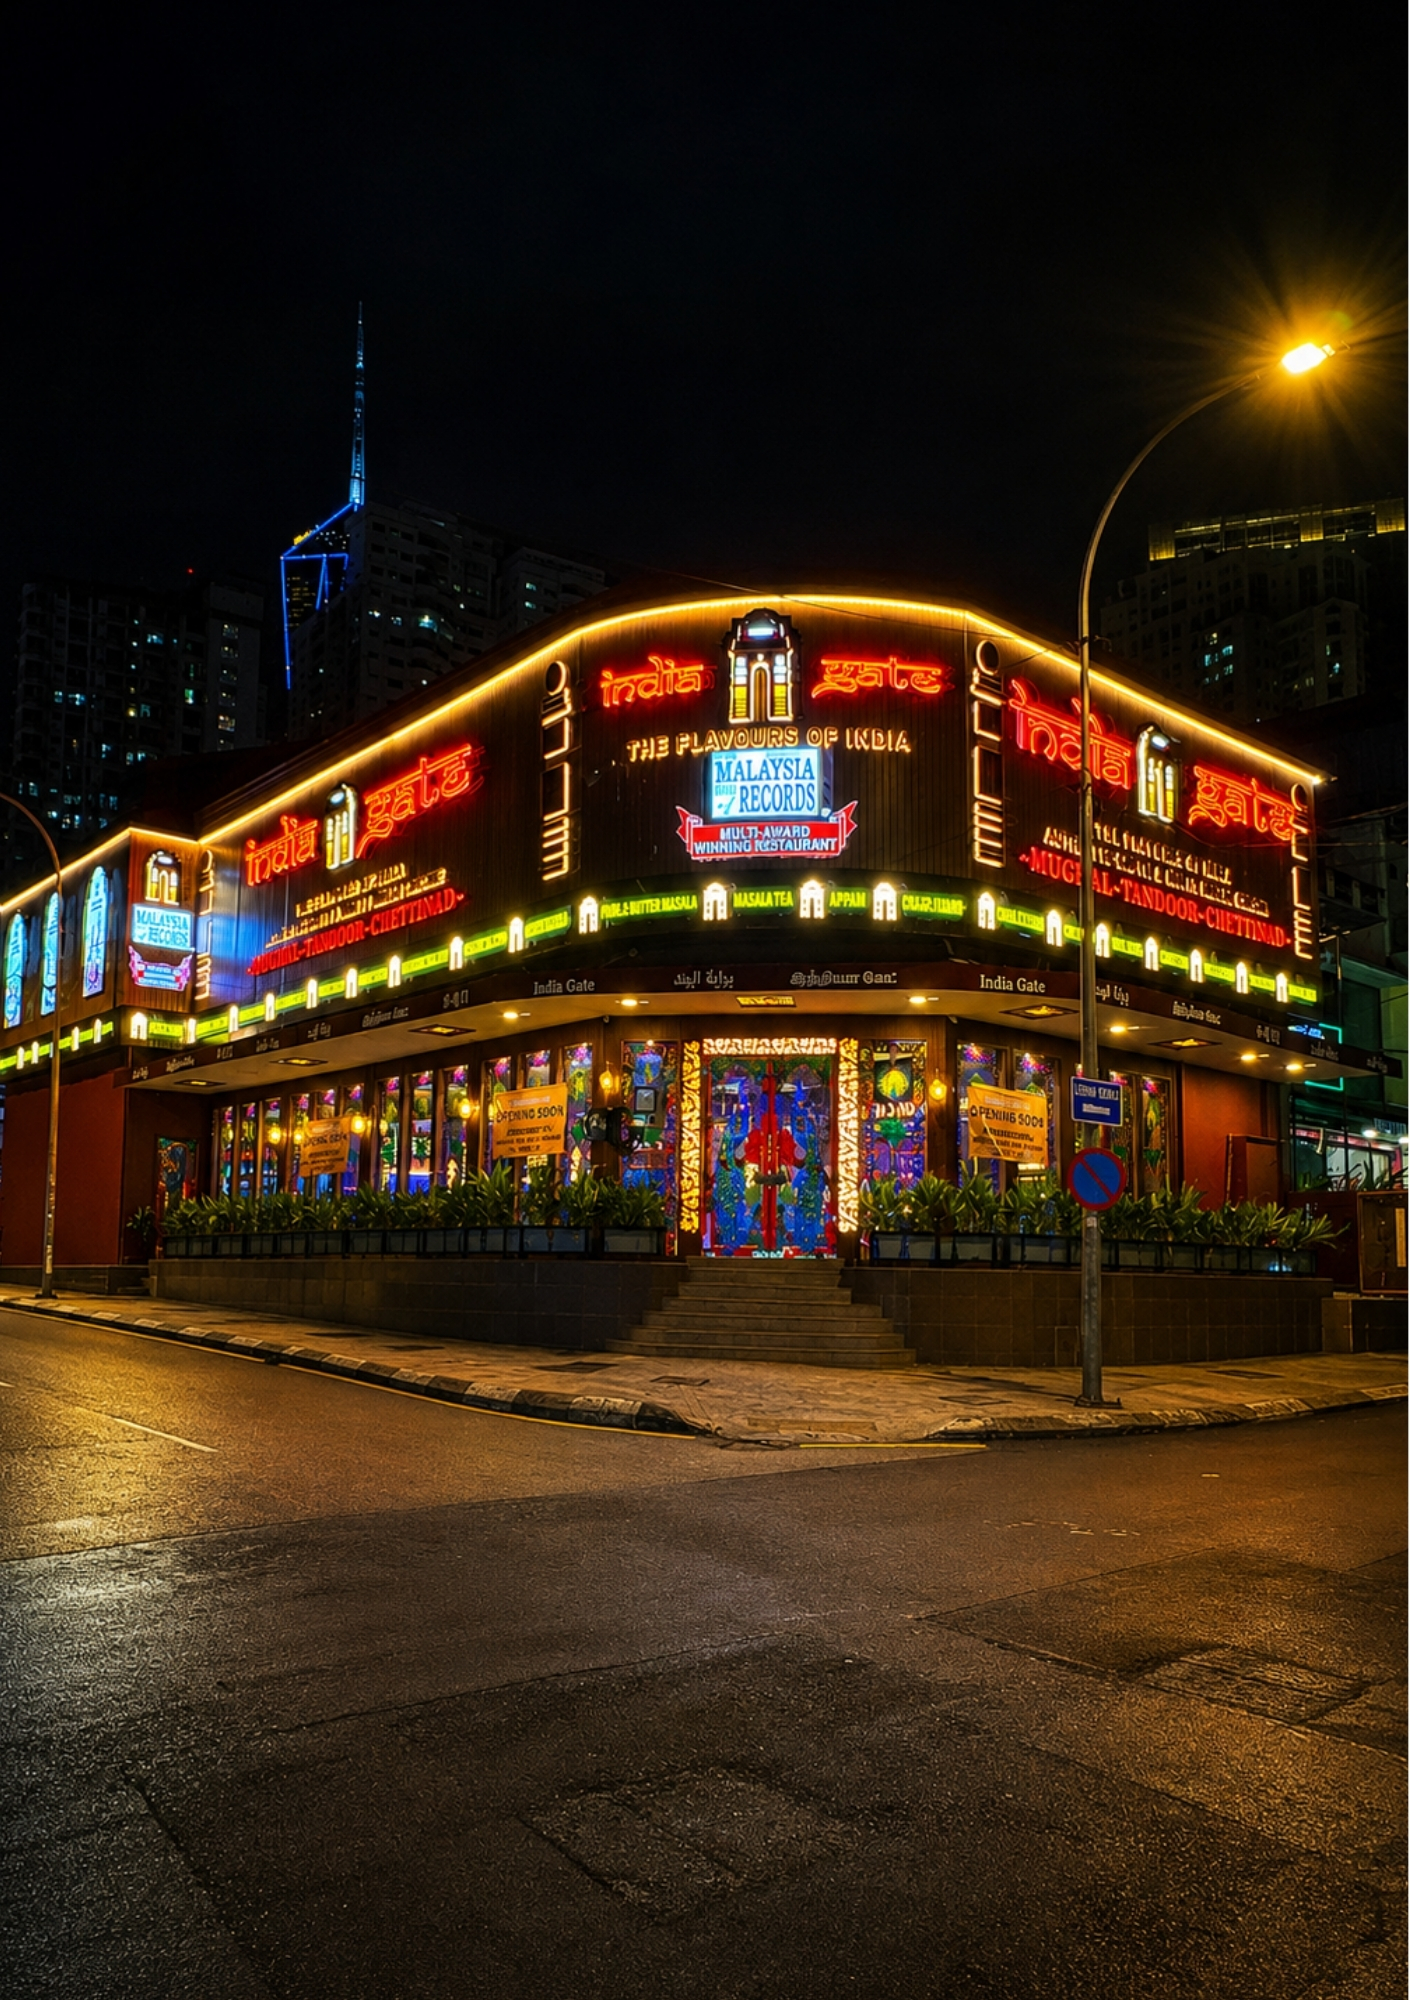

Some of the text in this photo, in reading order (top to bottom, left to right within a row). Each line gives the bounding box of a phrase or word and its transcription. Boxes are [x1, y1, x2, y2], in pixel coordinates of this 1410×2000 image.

[600, 655, 942, 707] india gate
[625, 726, 911, 762] THE FLAVOURS OF INDIA
[714, 757, 815, 783] MALAYSIA
[739, 783, 815, 813] RECORDS
[245, 742, 473, 887] india gate
[720, 825, 810, 841] MULTI-AWARD
[694, 840, 752, 856] WINNING
[733, 891, 794, 908] MASALA TEA
[533, 978, 595, 995] India Gate
[980, 973, 1046, 993] India Gate
